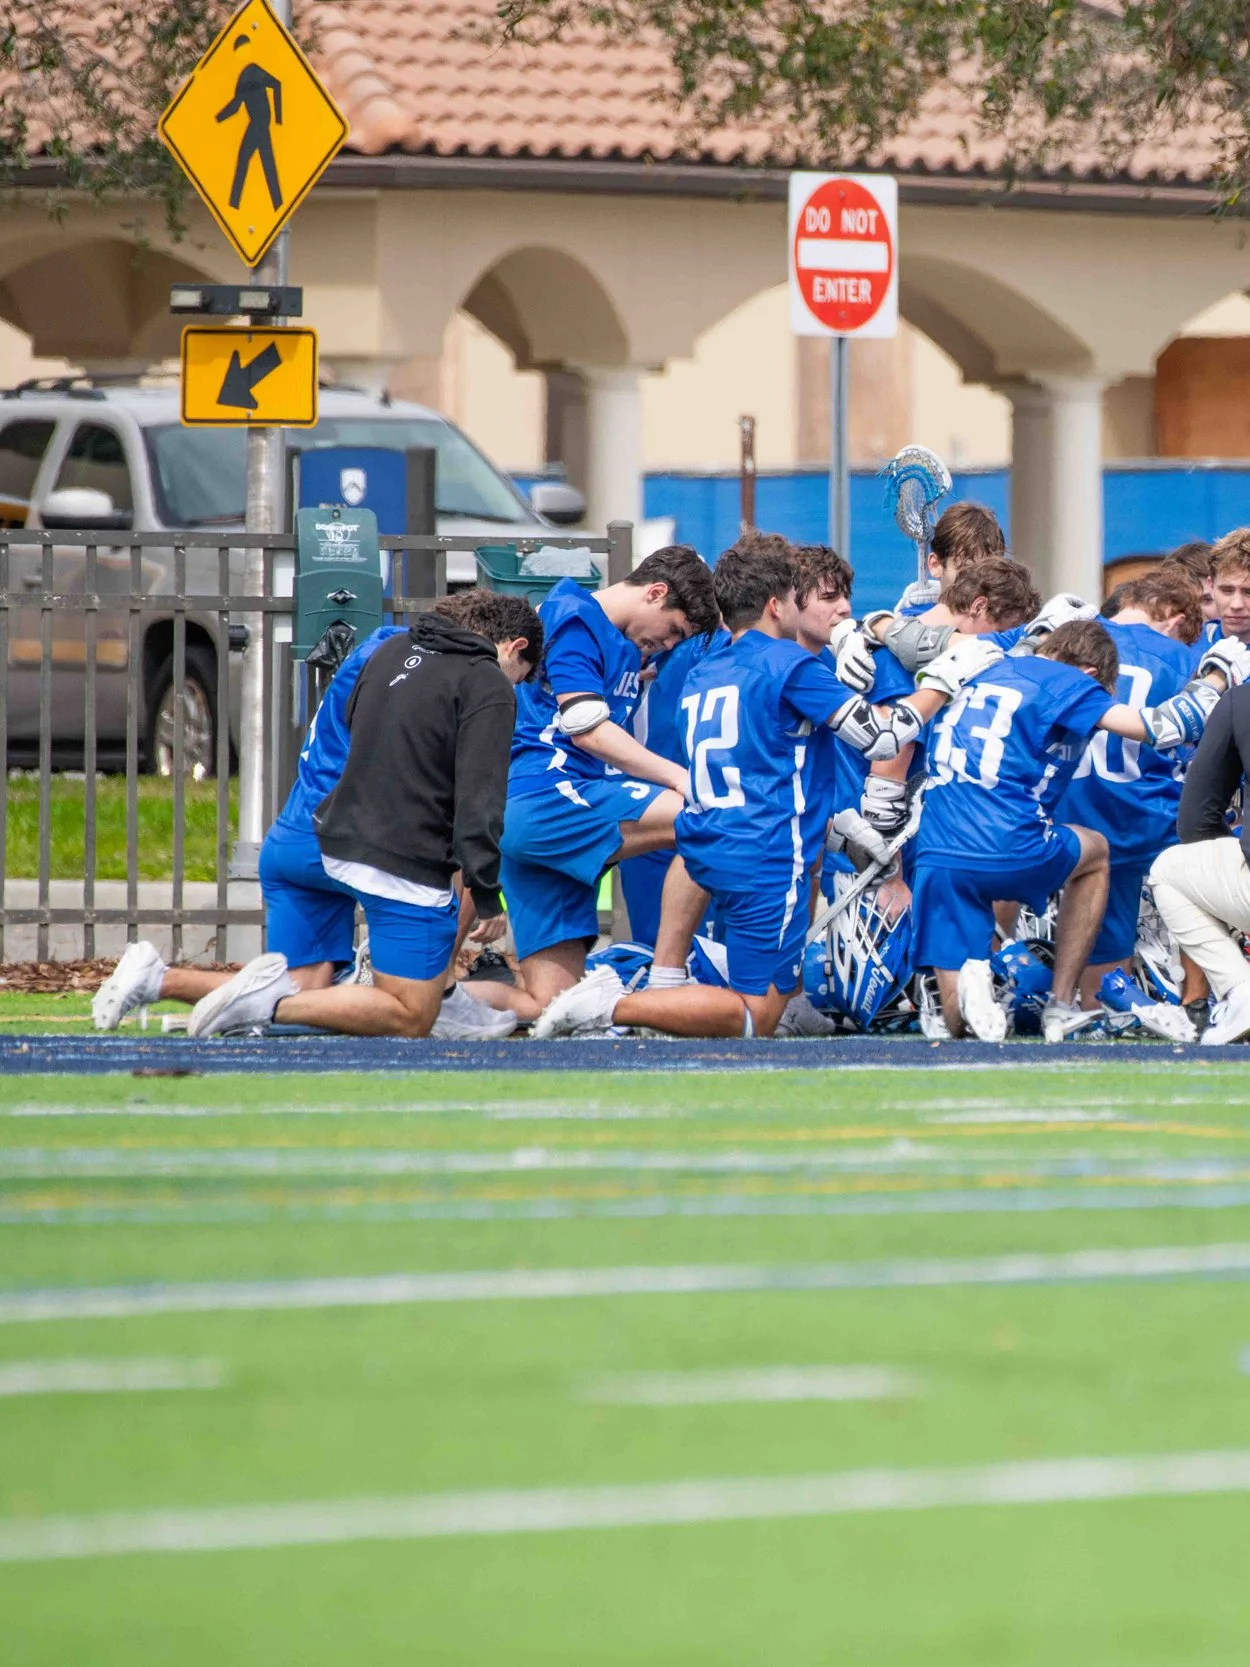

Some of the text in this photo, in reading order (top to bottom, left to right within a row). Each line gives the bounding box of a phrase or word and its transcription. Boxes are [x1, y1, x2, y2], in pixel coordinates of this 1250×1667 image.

[806, 206, 879, 235] DO NOT
[813, 276, 872, 304] ENTER
[681, 685, 746, 814] 12
